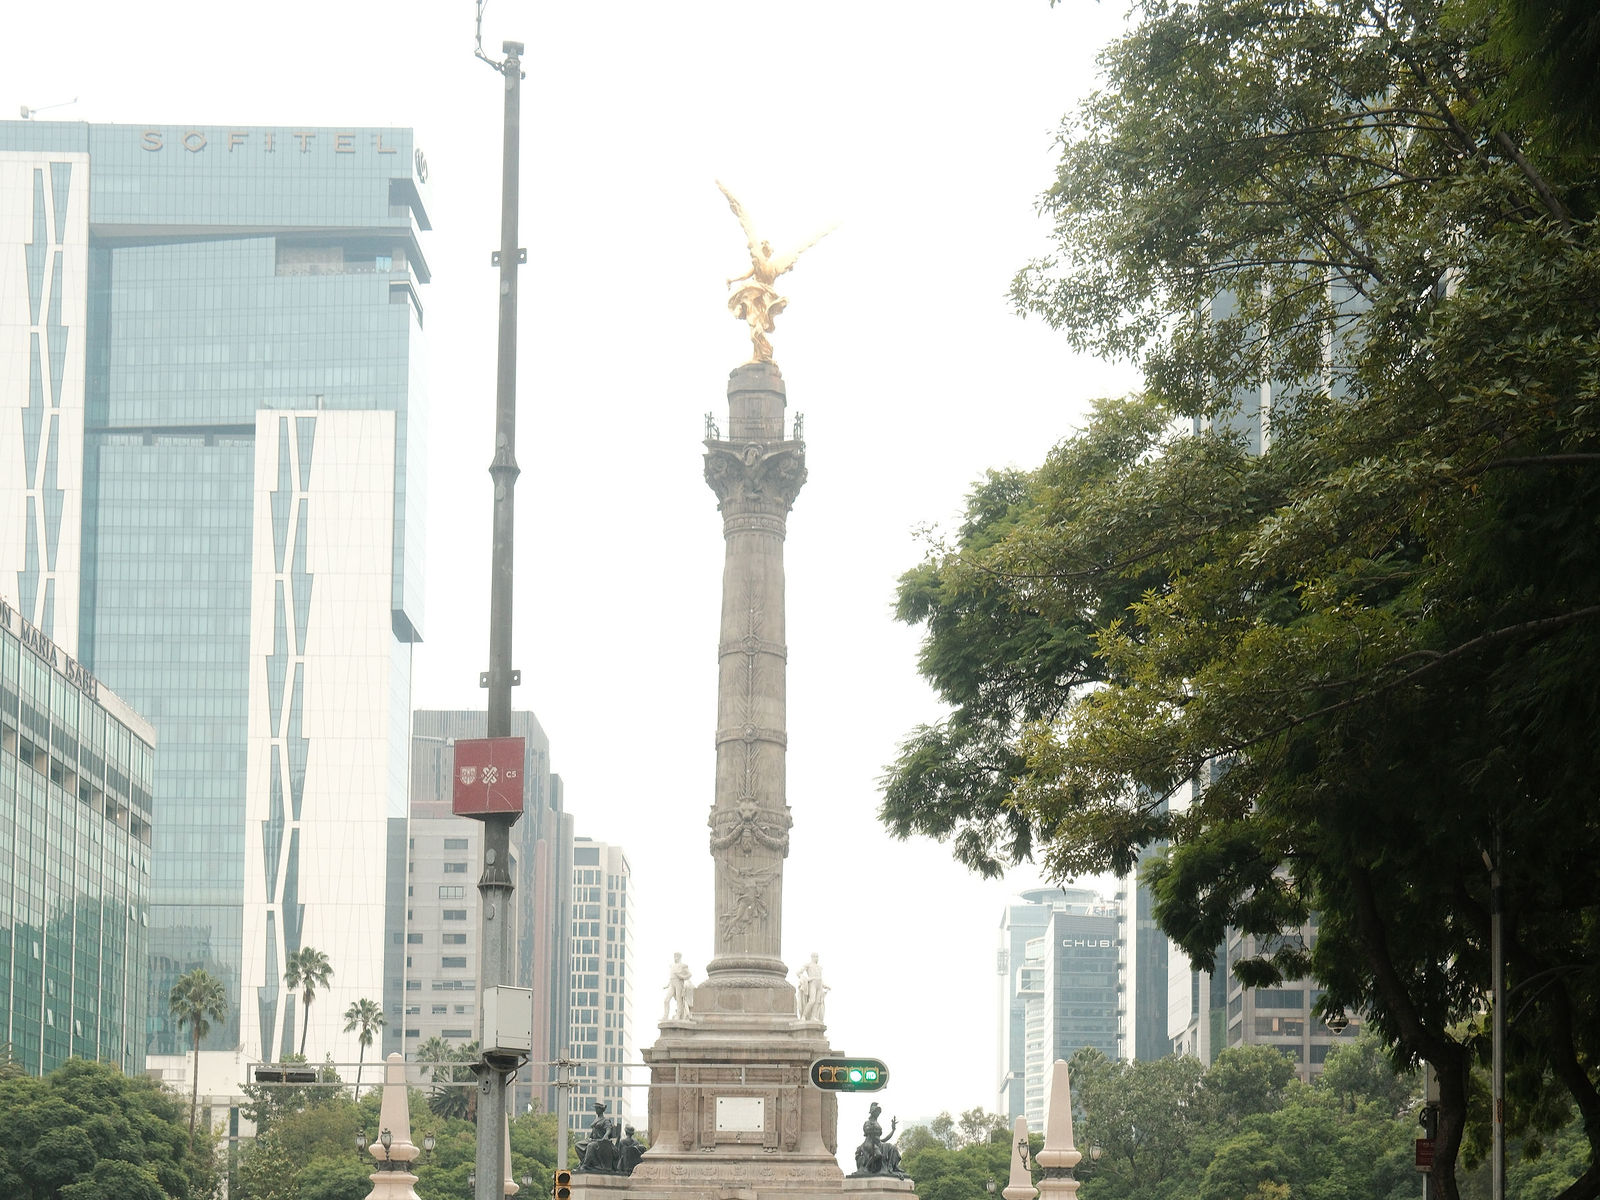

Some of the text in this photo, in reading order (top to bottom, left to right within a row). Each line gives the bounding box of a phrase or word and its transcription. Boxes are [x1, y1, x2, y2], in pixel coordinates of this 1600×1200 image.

[141, 130, 397, 153] SOFITEL
[21, 619, 58, 667] MARIA
[65, 655, 100, 702] ISABEL
